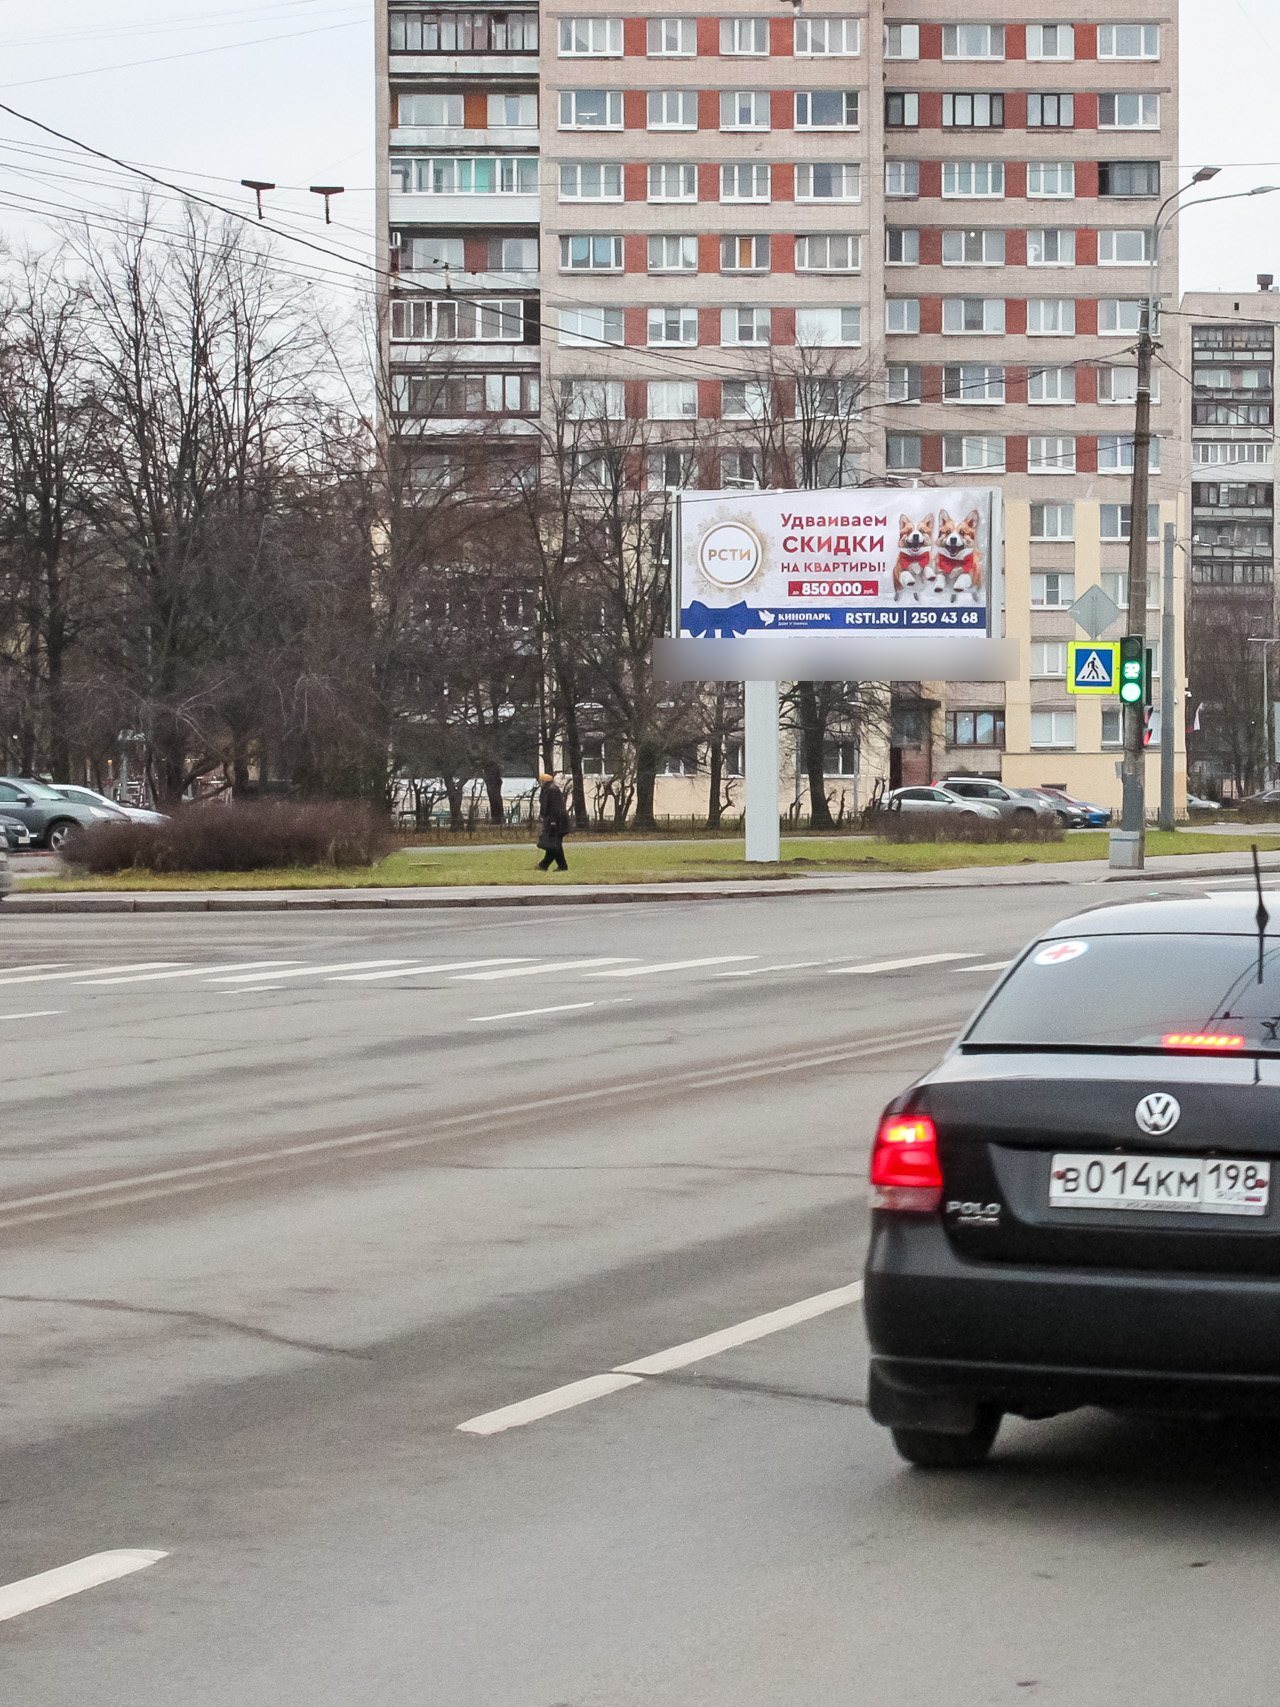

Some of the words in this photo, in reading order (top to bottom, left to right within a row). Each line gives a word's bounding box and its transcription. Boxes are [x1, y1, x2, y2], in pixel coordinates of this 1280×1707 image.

[781, 513, 887, 530] Удваиваем
[782, 535, 885, 556] СКИДКИ
[708, 548, 751, 561] РСТИ
[781, 562, 800, 573] НА
[804, 562, 886, 573] КВАРТИРЫ!
[801, 583, 829, 595] 850
[832, 583, 862, 595] 000
[778, 613, 831, 621] КИНОПАРК
[845, 612, 899, 625] RSTI.RU
[911, 612, 937, 624] 250
[940, 612, 957, 624] 43
[961, 612, 979, 624] 68
[1063, 1160, 1199, 1198] В014КМ
[1208, 1163, 1259, 1190] 198
[946, 1200, 1001, 1215] POLO
